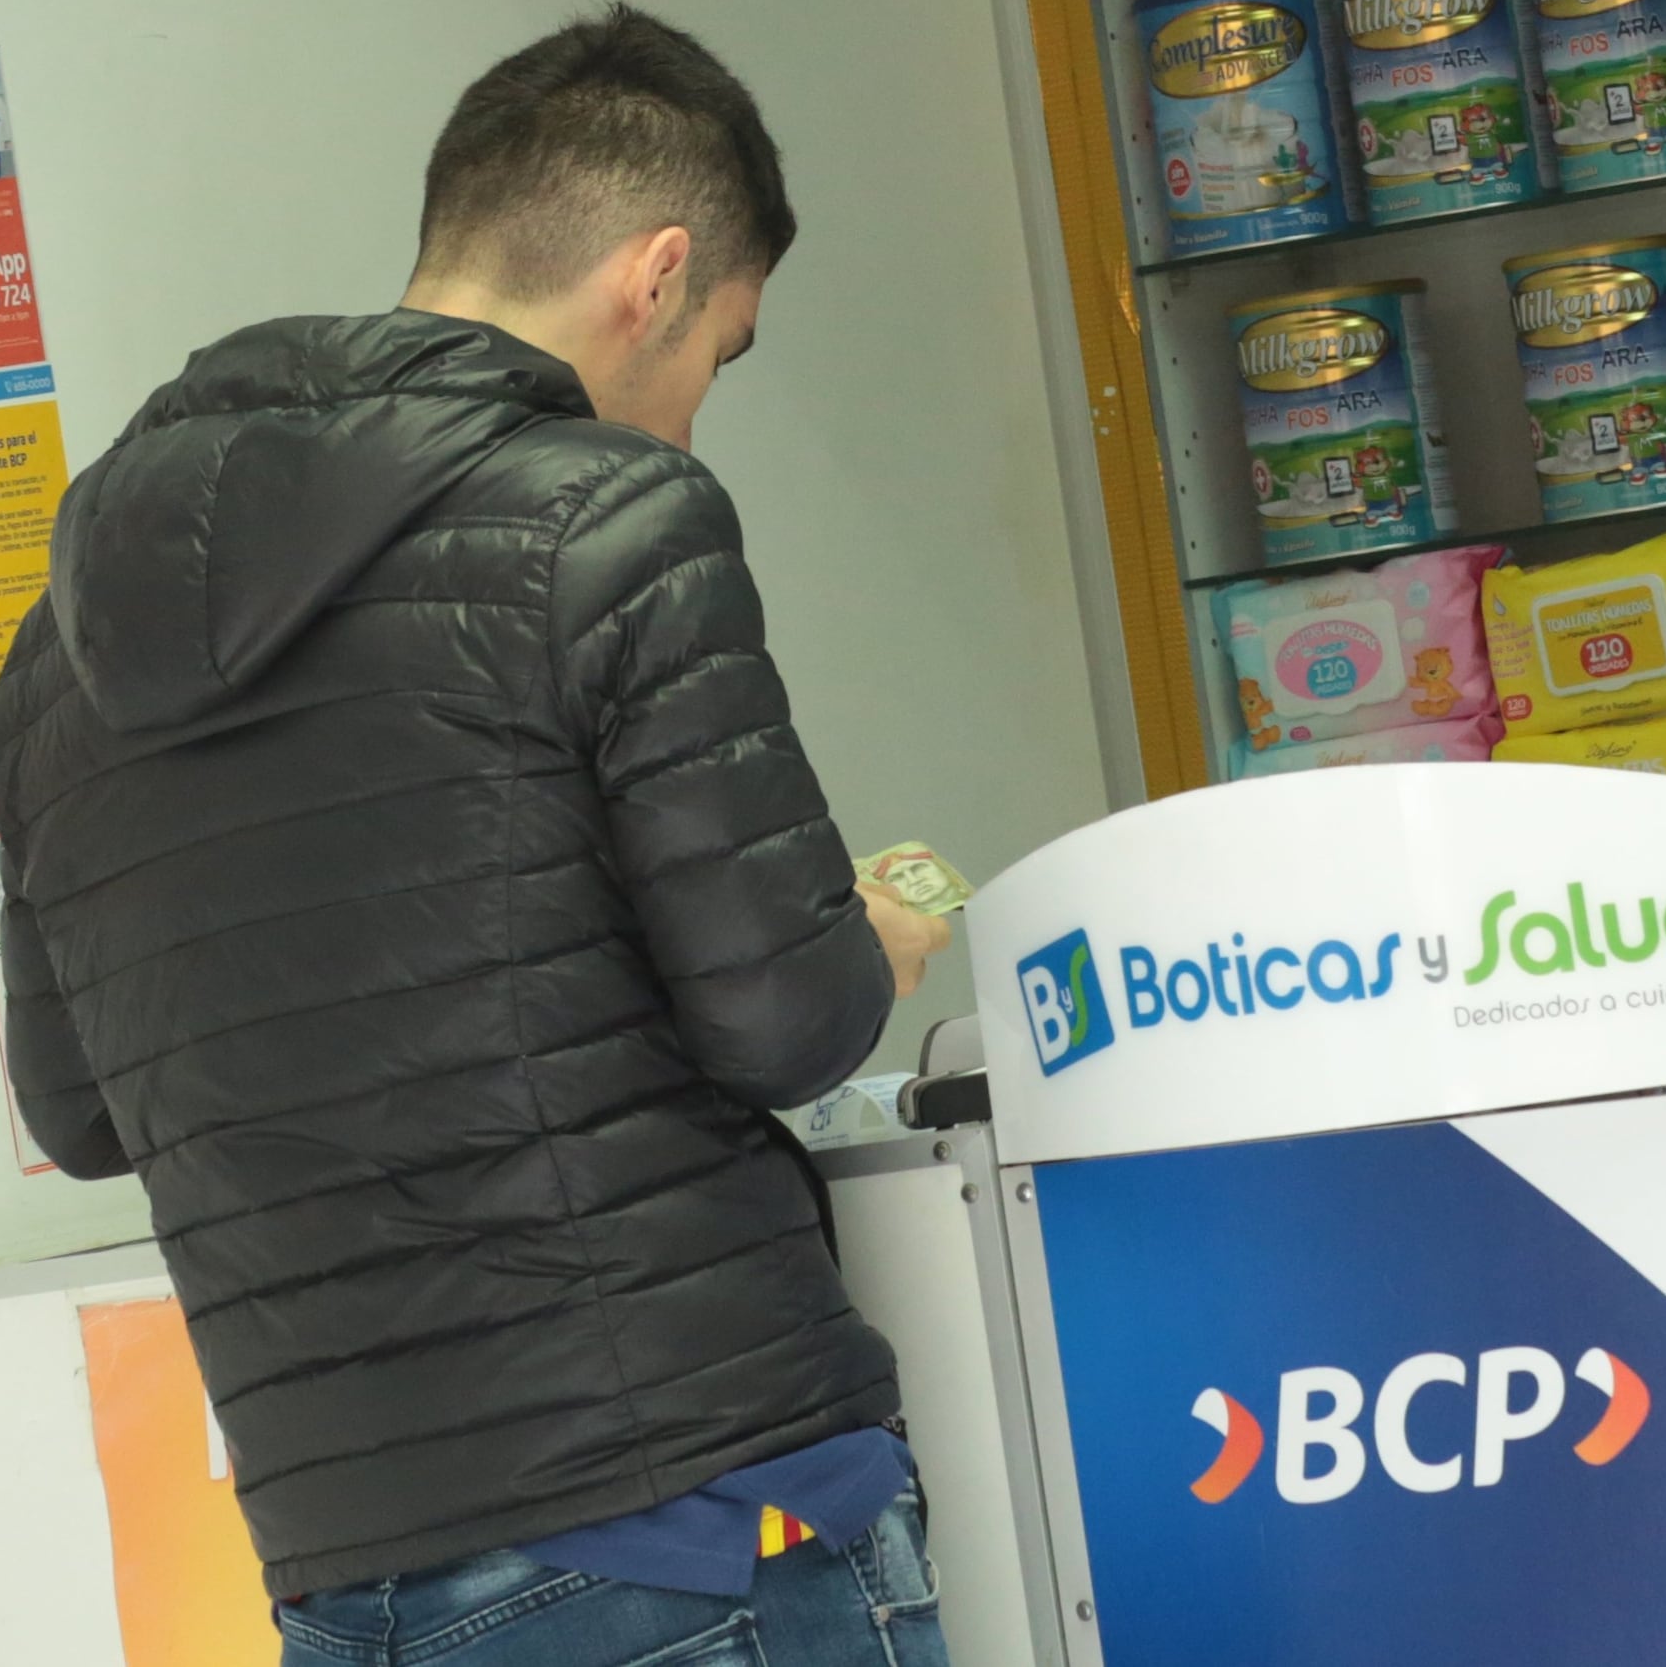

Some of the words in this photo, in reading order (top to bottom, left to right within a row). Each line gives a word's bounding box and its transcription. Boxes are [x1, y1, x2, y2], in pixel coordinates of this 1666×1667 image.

[1, 284, 31, 307] 724
[6, 435, 26, 450] para
[28, 430, 36, 444] el
[10, 453, 27, 466] BCP
[1119, 929, 1400, 1029] Boticas
[1417, 931, 1450, 984] y
[1275, 1346, 1566, 1506] BCP
